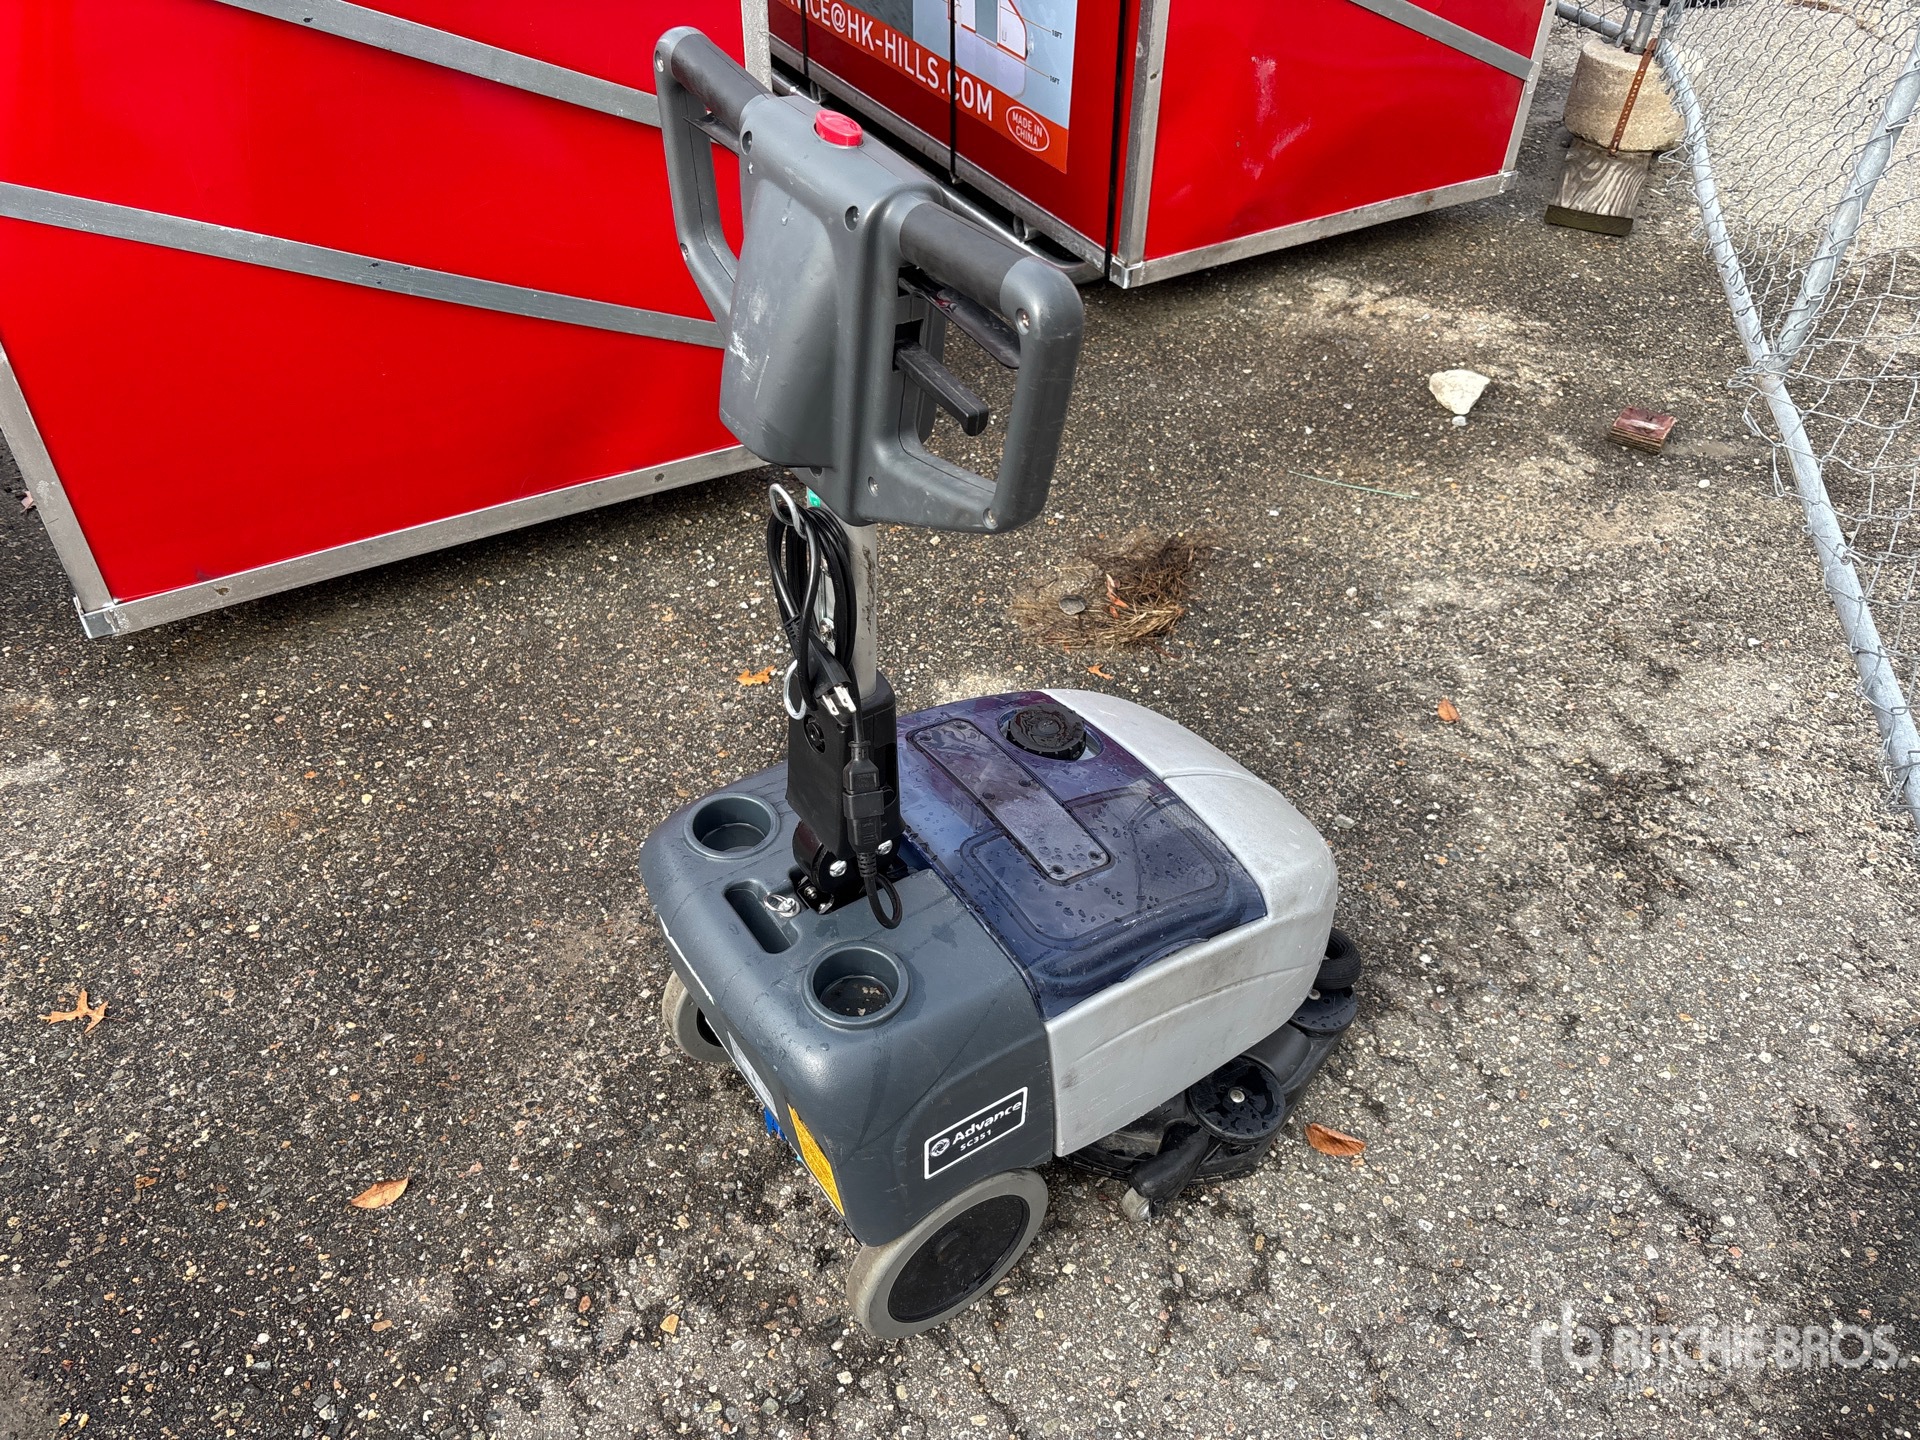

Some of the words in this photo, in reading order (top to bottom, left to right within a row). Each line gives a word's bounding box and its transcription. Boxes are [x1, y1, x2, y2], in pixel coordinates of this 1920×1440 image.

[1012, 111, 1032, 132] MADE
[1034, 124, 1043, 138] IN
[1016, 125, 1038, 148] CHINA
[952, 1101, 1022, 1145] Advance
[960, 1129, 992, 1151] SC351
